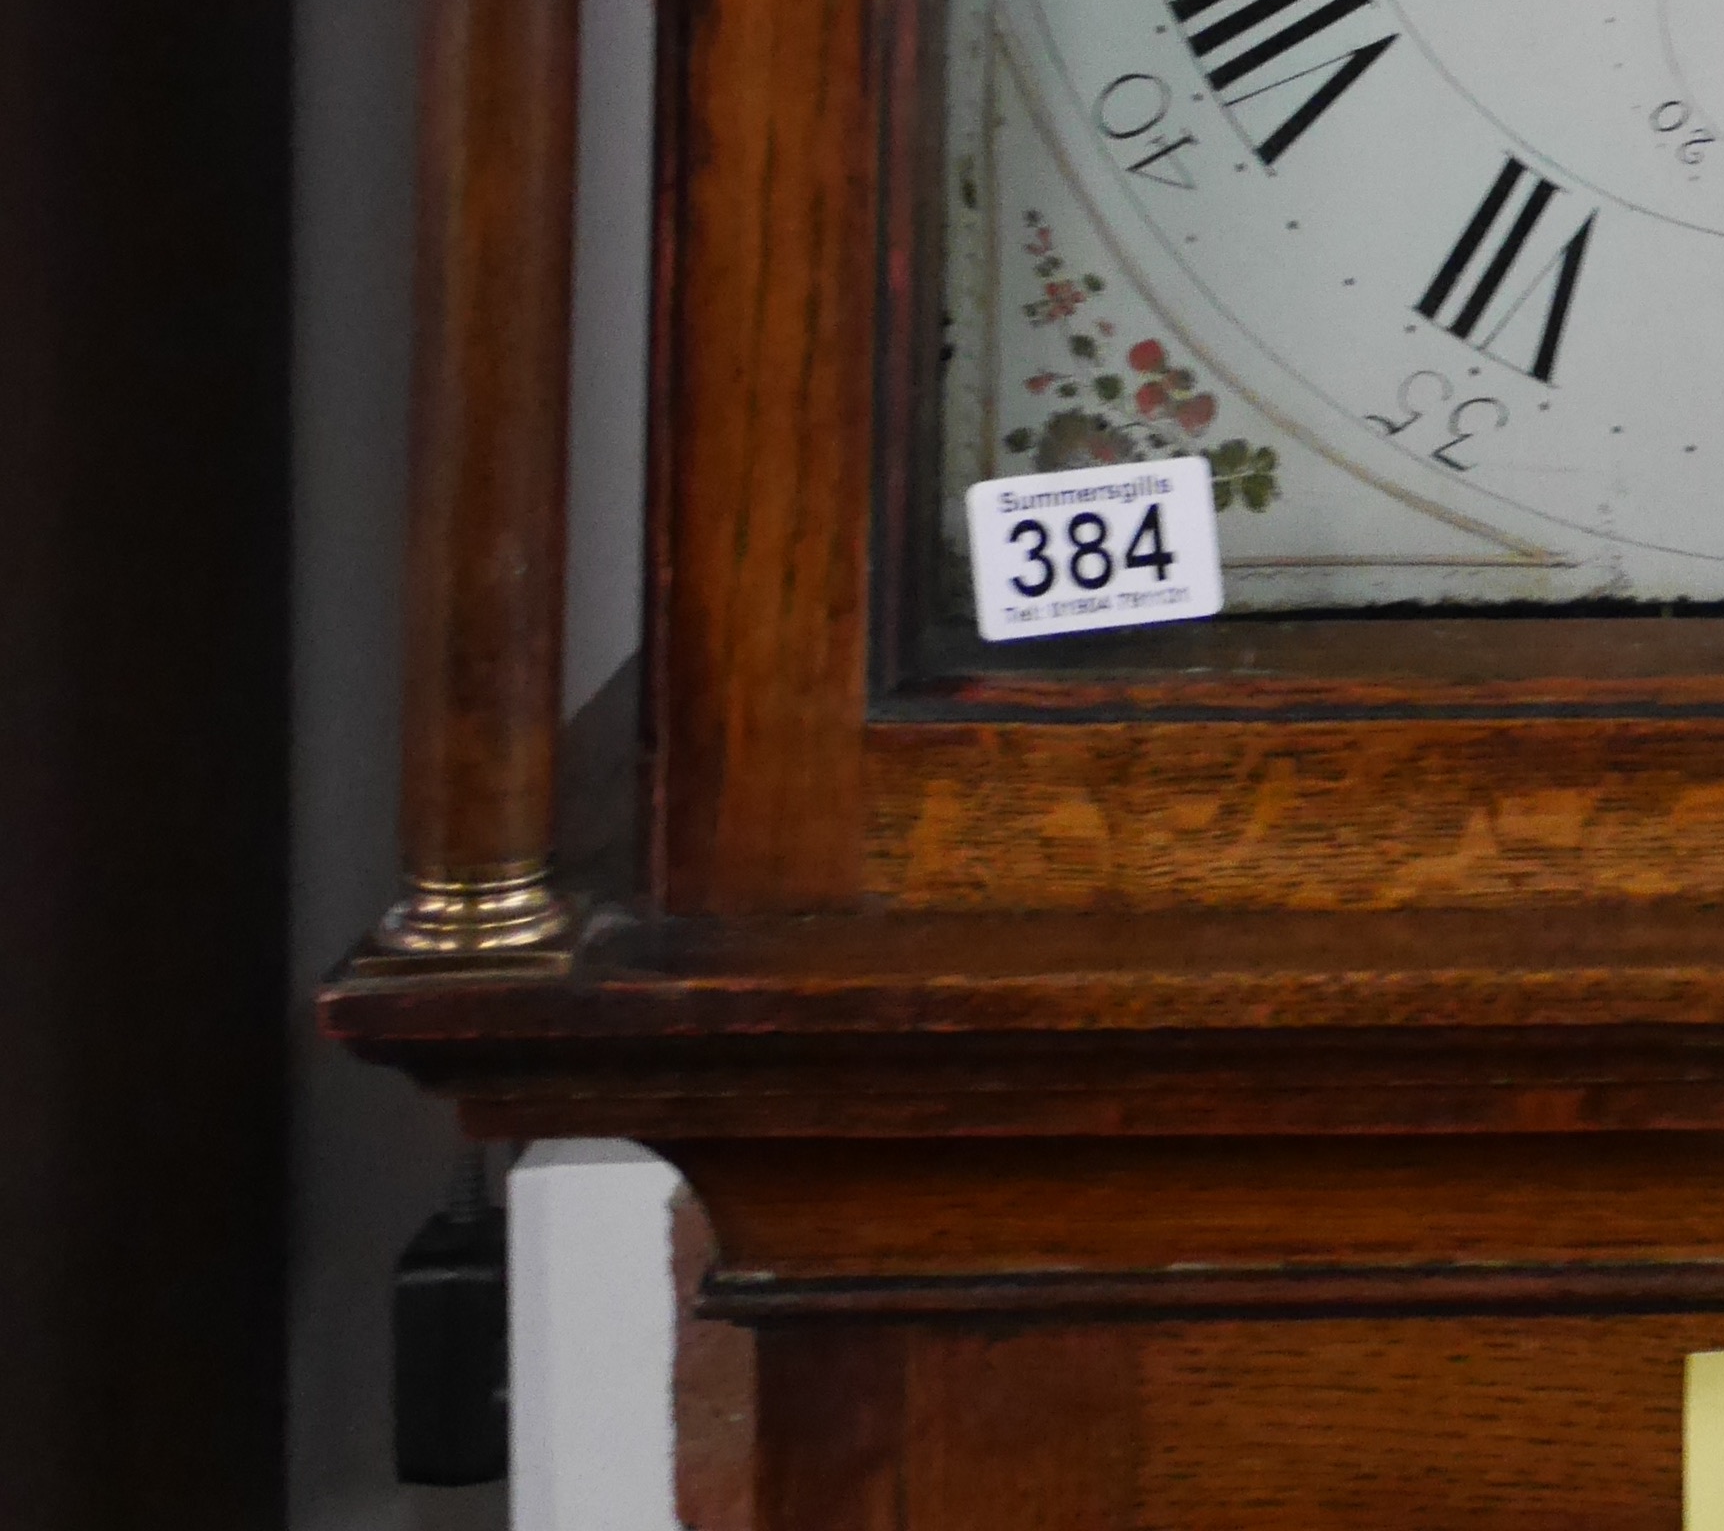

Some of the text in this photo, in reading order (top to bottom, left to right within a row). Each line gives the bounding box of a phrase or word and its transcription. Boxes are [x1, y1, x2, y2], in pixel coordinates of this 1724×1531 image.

[1095, 73, 1200, 190] 40
[1650, 100, 1715, 164] 20
[1412, 151, 1600, 389] VII
[1364, 370, 1509, 472] 35
[1009, 502, 1176, 598] 384
